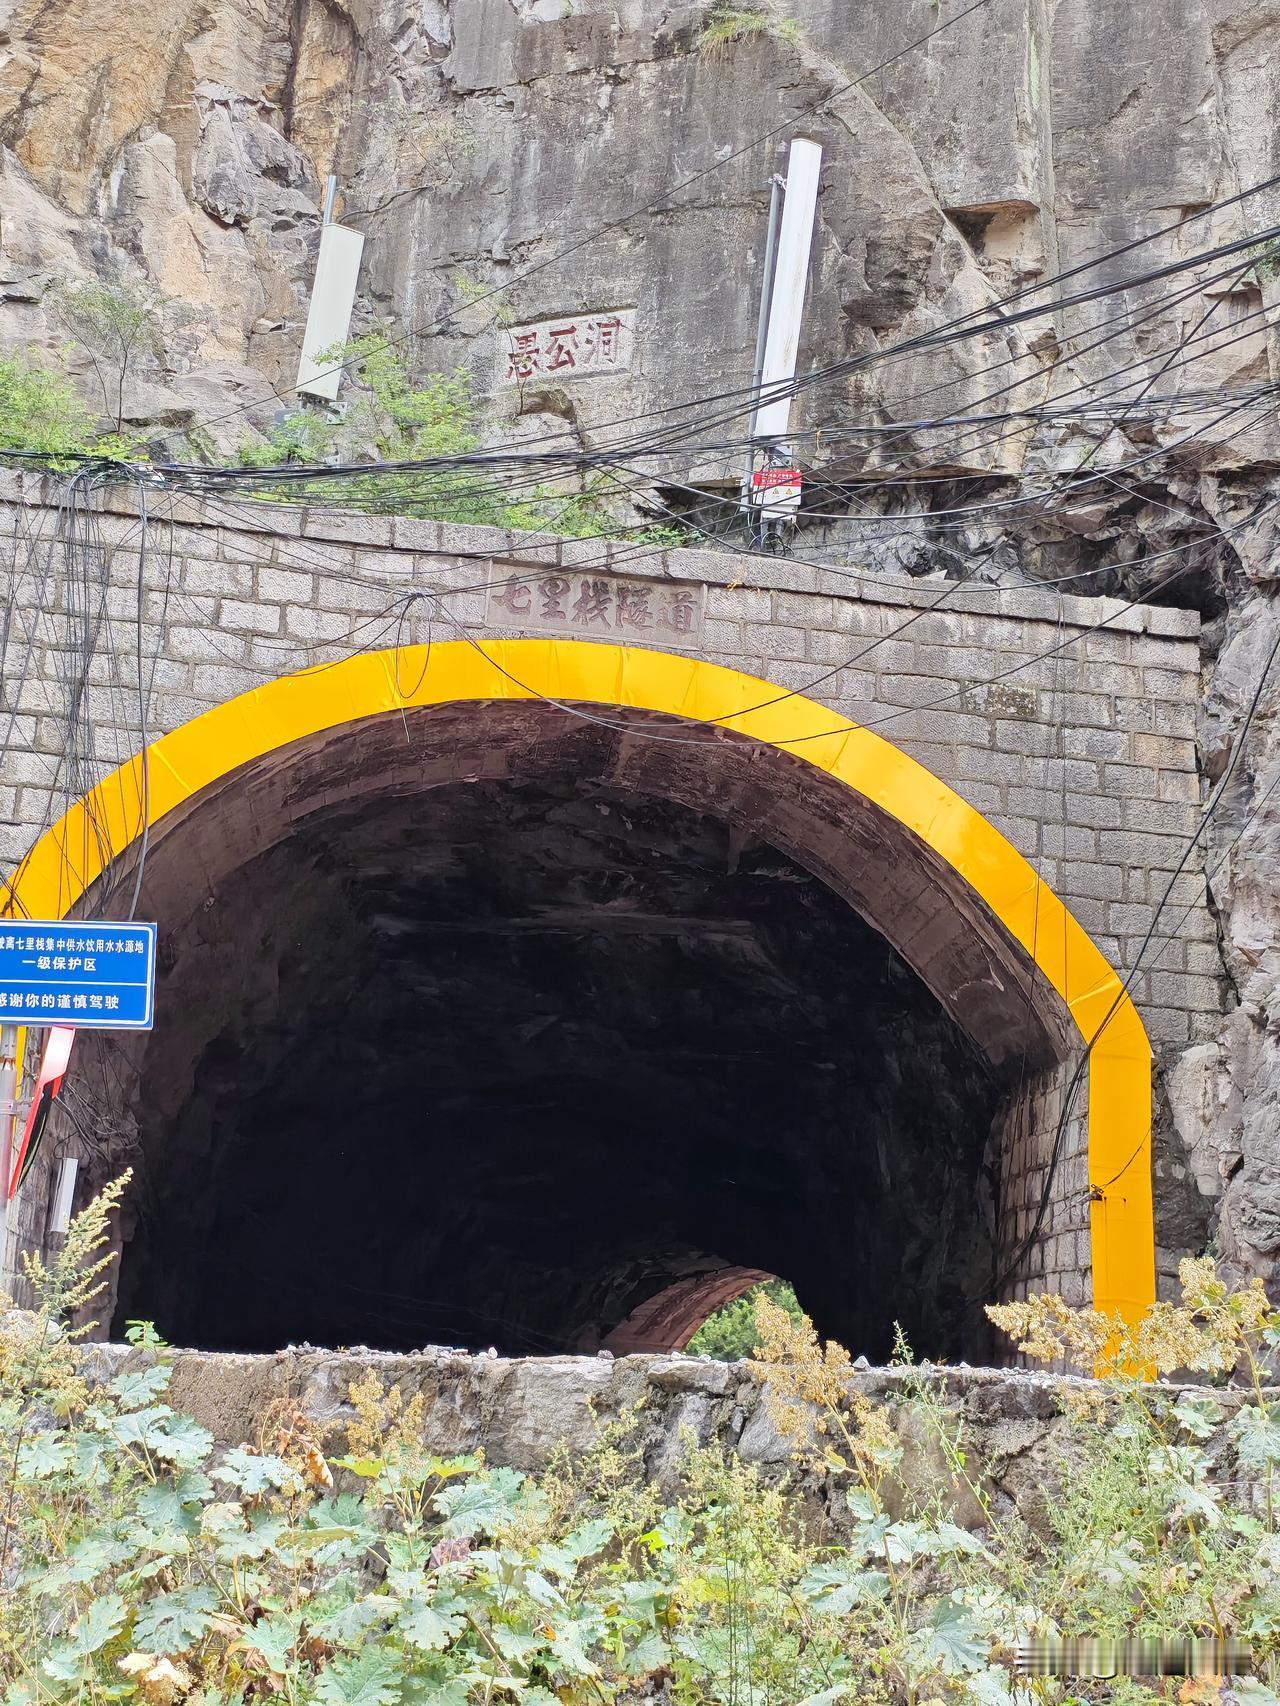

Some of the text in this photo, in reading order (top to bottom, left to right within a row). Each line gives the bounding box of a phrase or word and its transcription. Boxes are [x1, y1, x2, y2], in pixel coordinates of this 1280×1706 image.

[22, 956, 97, 972] 一级保护区
[0, 993, 119, 1010] 感谢你的谨慎驾驶
